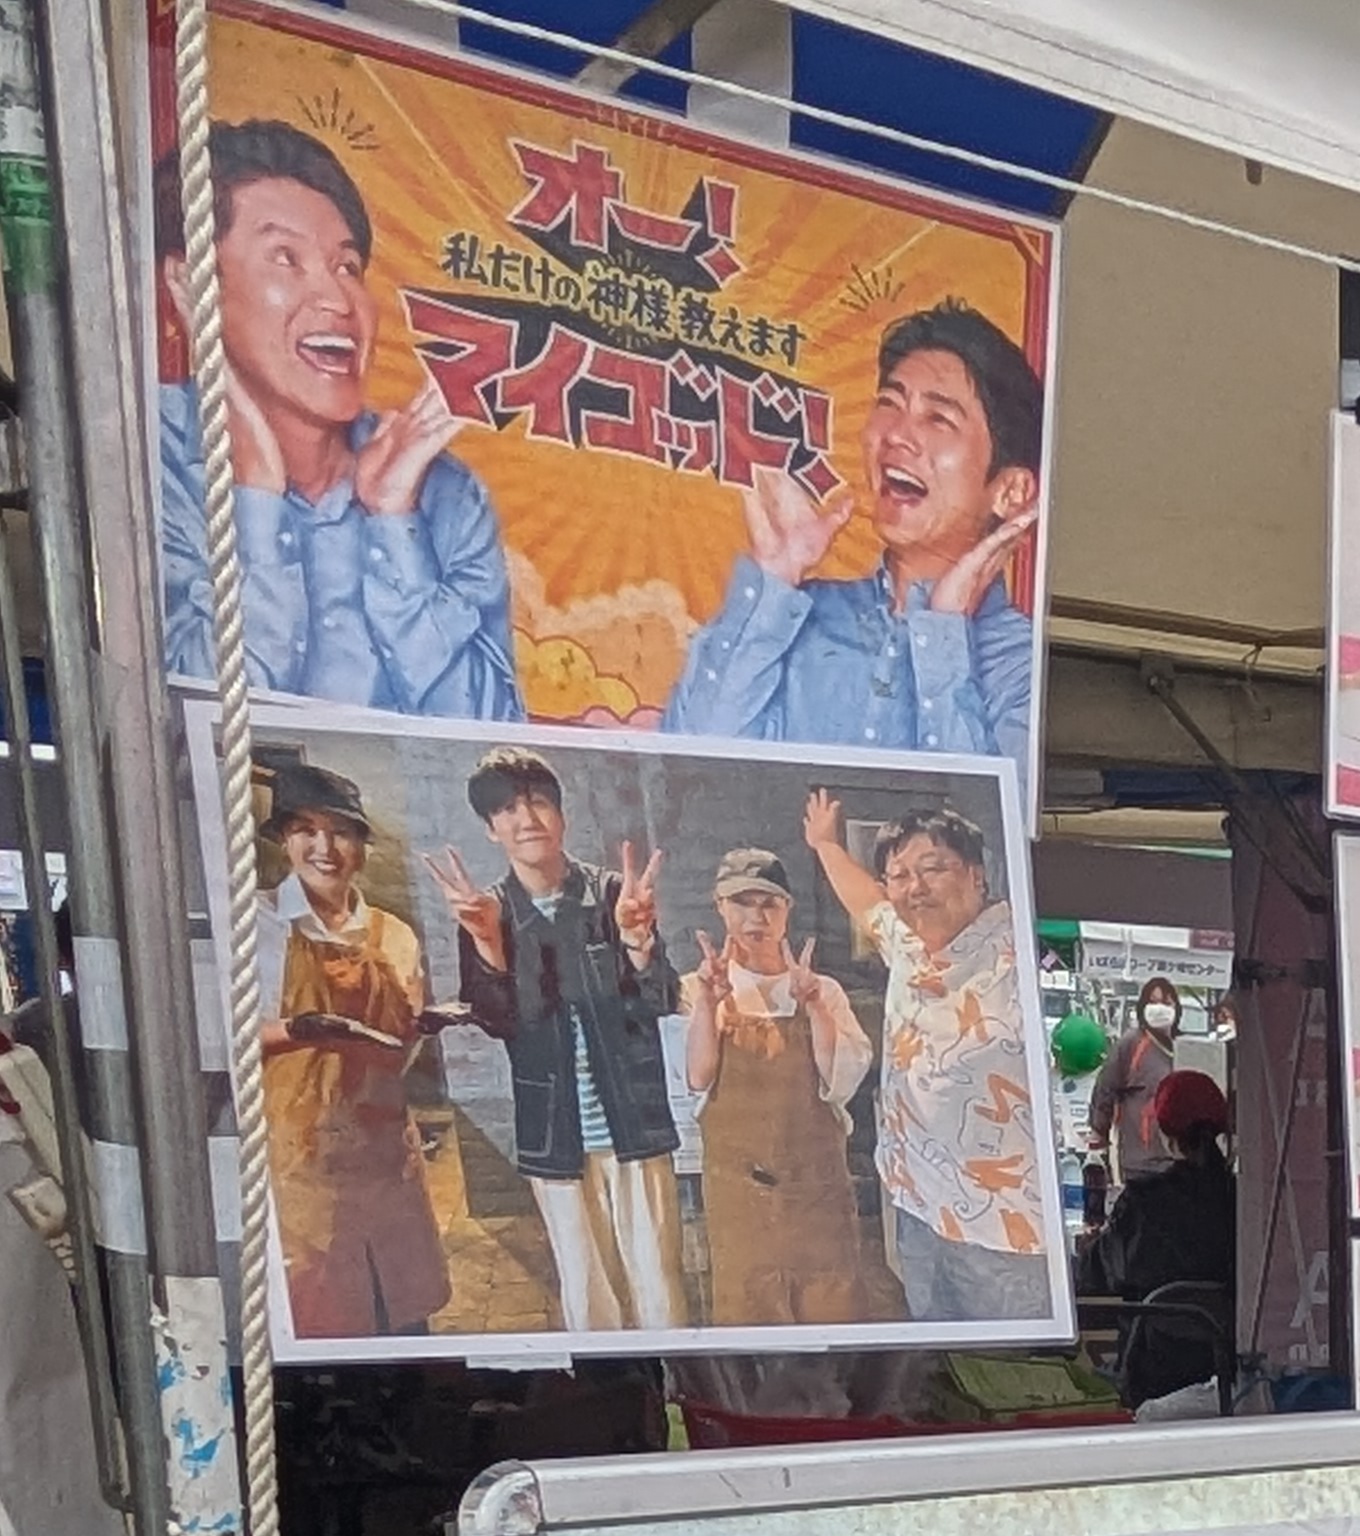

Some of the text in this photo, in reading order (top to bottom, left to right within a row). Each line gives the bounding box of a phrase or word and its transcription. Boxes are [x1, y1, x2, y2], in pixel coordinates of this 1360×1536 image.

[402, 290, 848, 503] マイゴッド!
